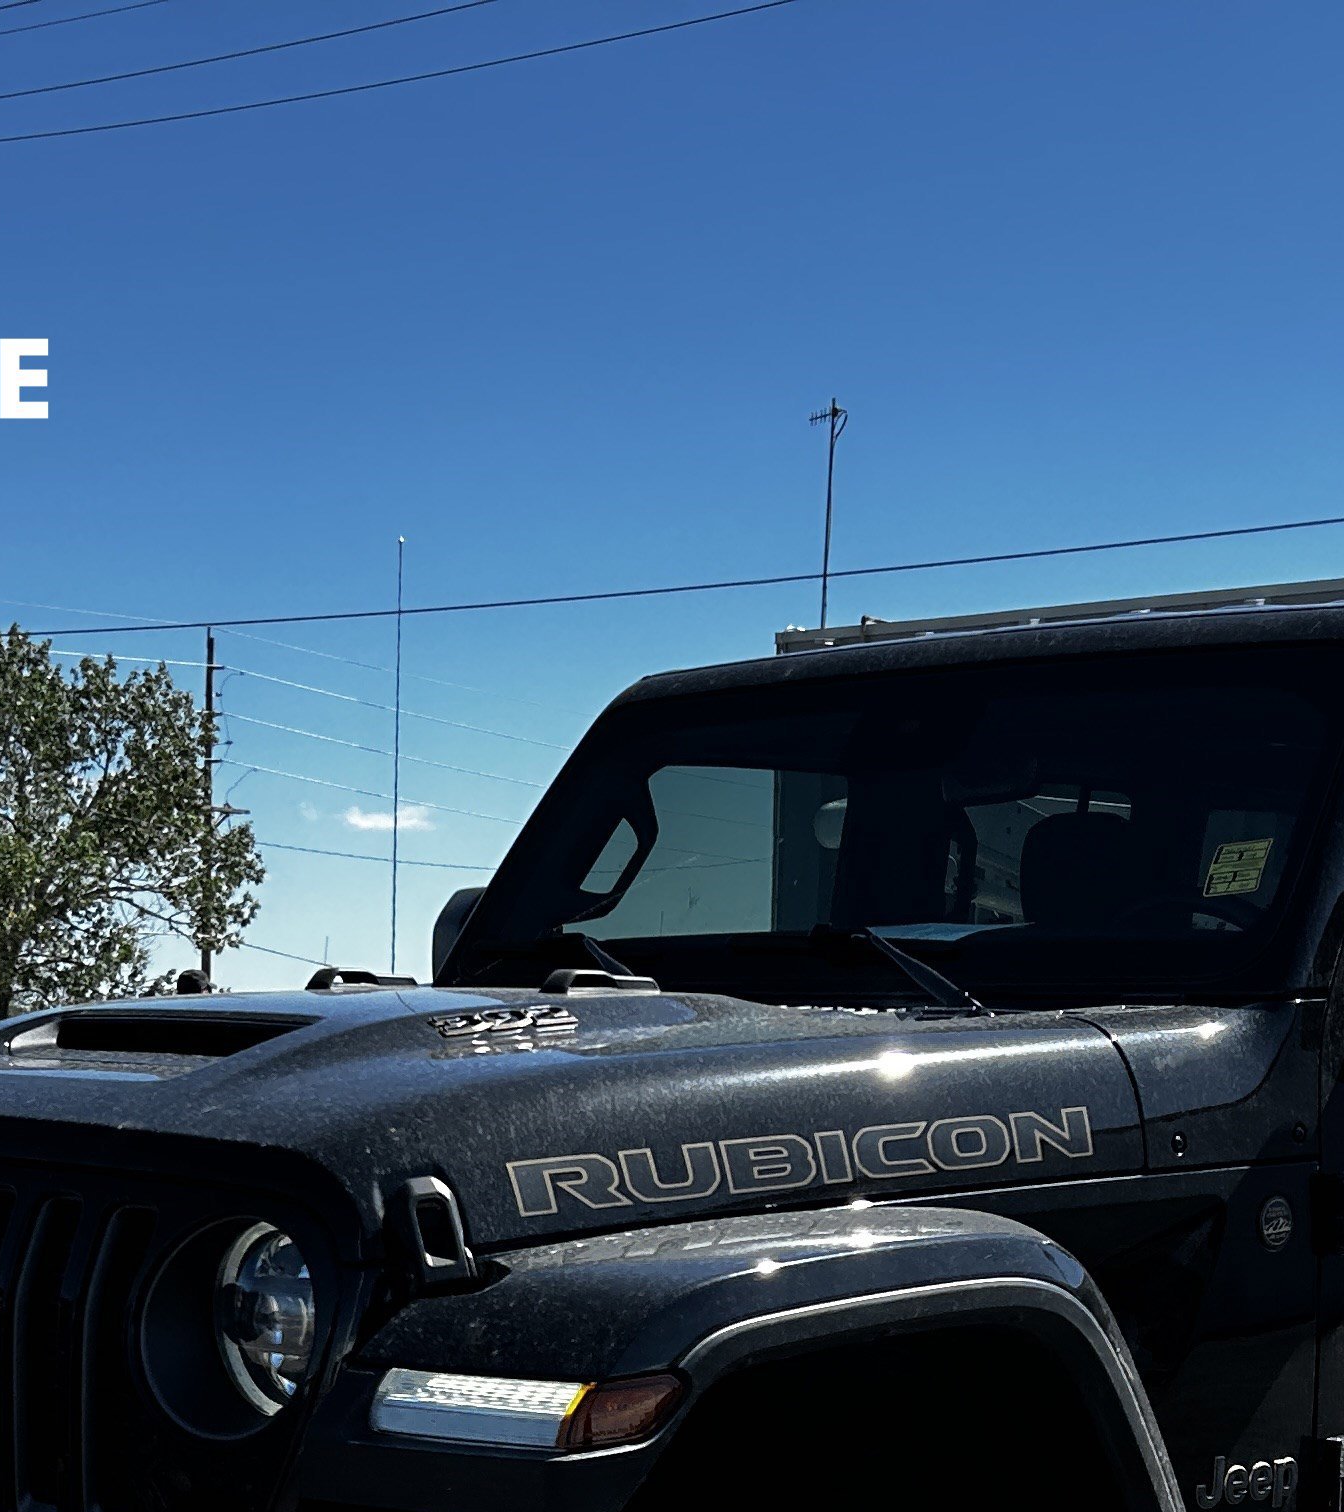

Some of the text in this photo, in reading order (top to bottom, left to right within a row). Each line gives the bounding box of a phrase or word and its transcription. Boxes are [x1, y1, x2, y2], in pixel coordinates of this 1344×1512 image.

[427, 1004, 579, 1038] 392
[505, 1106, 1093, 1218] RUBICON
[1195, 1455, 1299, 1510] Jeep
